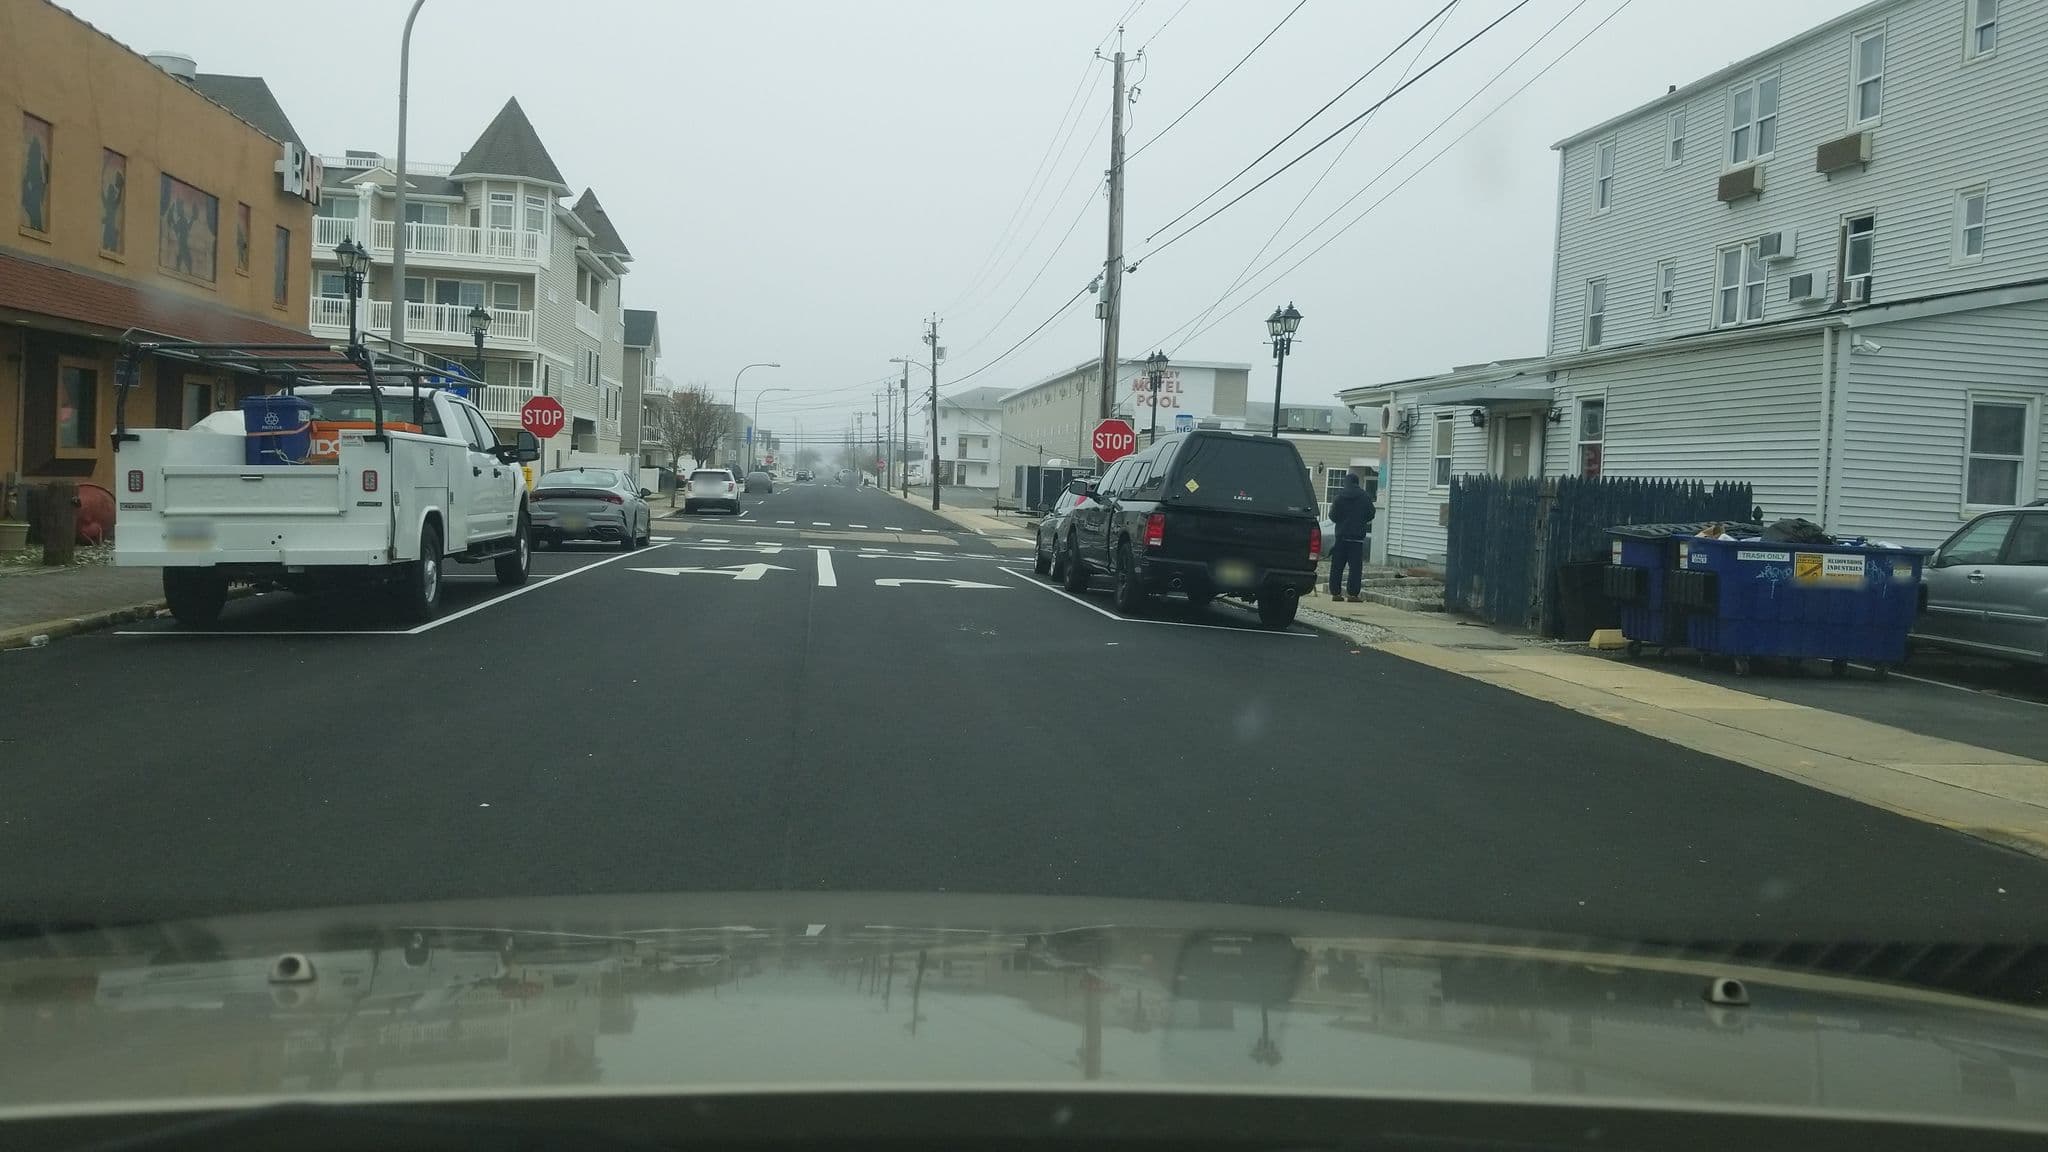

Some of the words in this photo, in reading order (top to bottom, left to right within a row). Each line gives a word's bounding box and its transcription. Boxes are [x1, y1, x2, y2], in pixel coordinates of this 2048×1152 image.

[283, 141, 323, 206] BAR
[1132, 379, 1183, 393] MOTEL
[1136, 393, 1180, 408] POOL
[523, 409, 562, 426] STOP
[1095, 432, 1133, 450] STOP
[1742, 552, 1766, 560] TRASH
